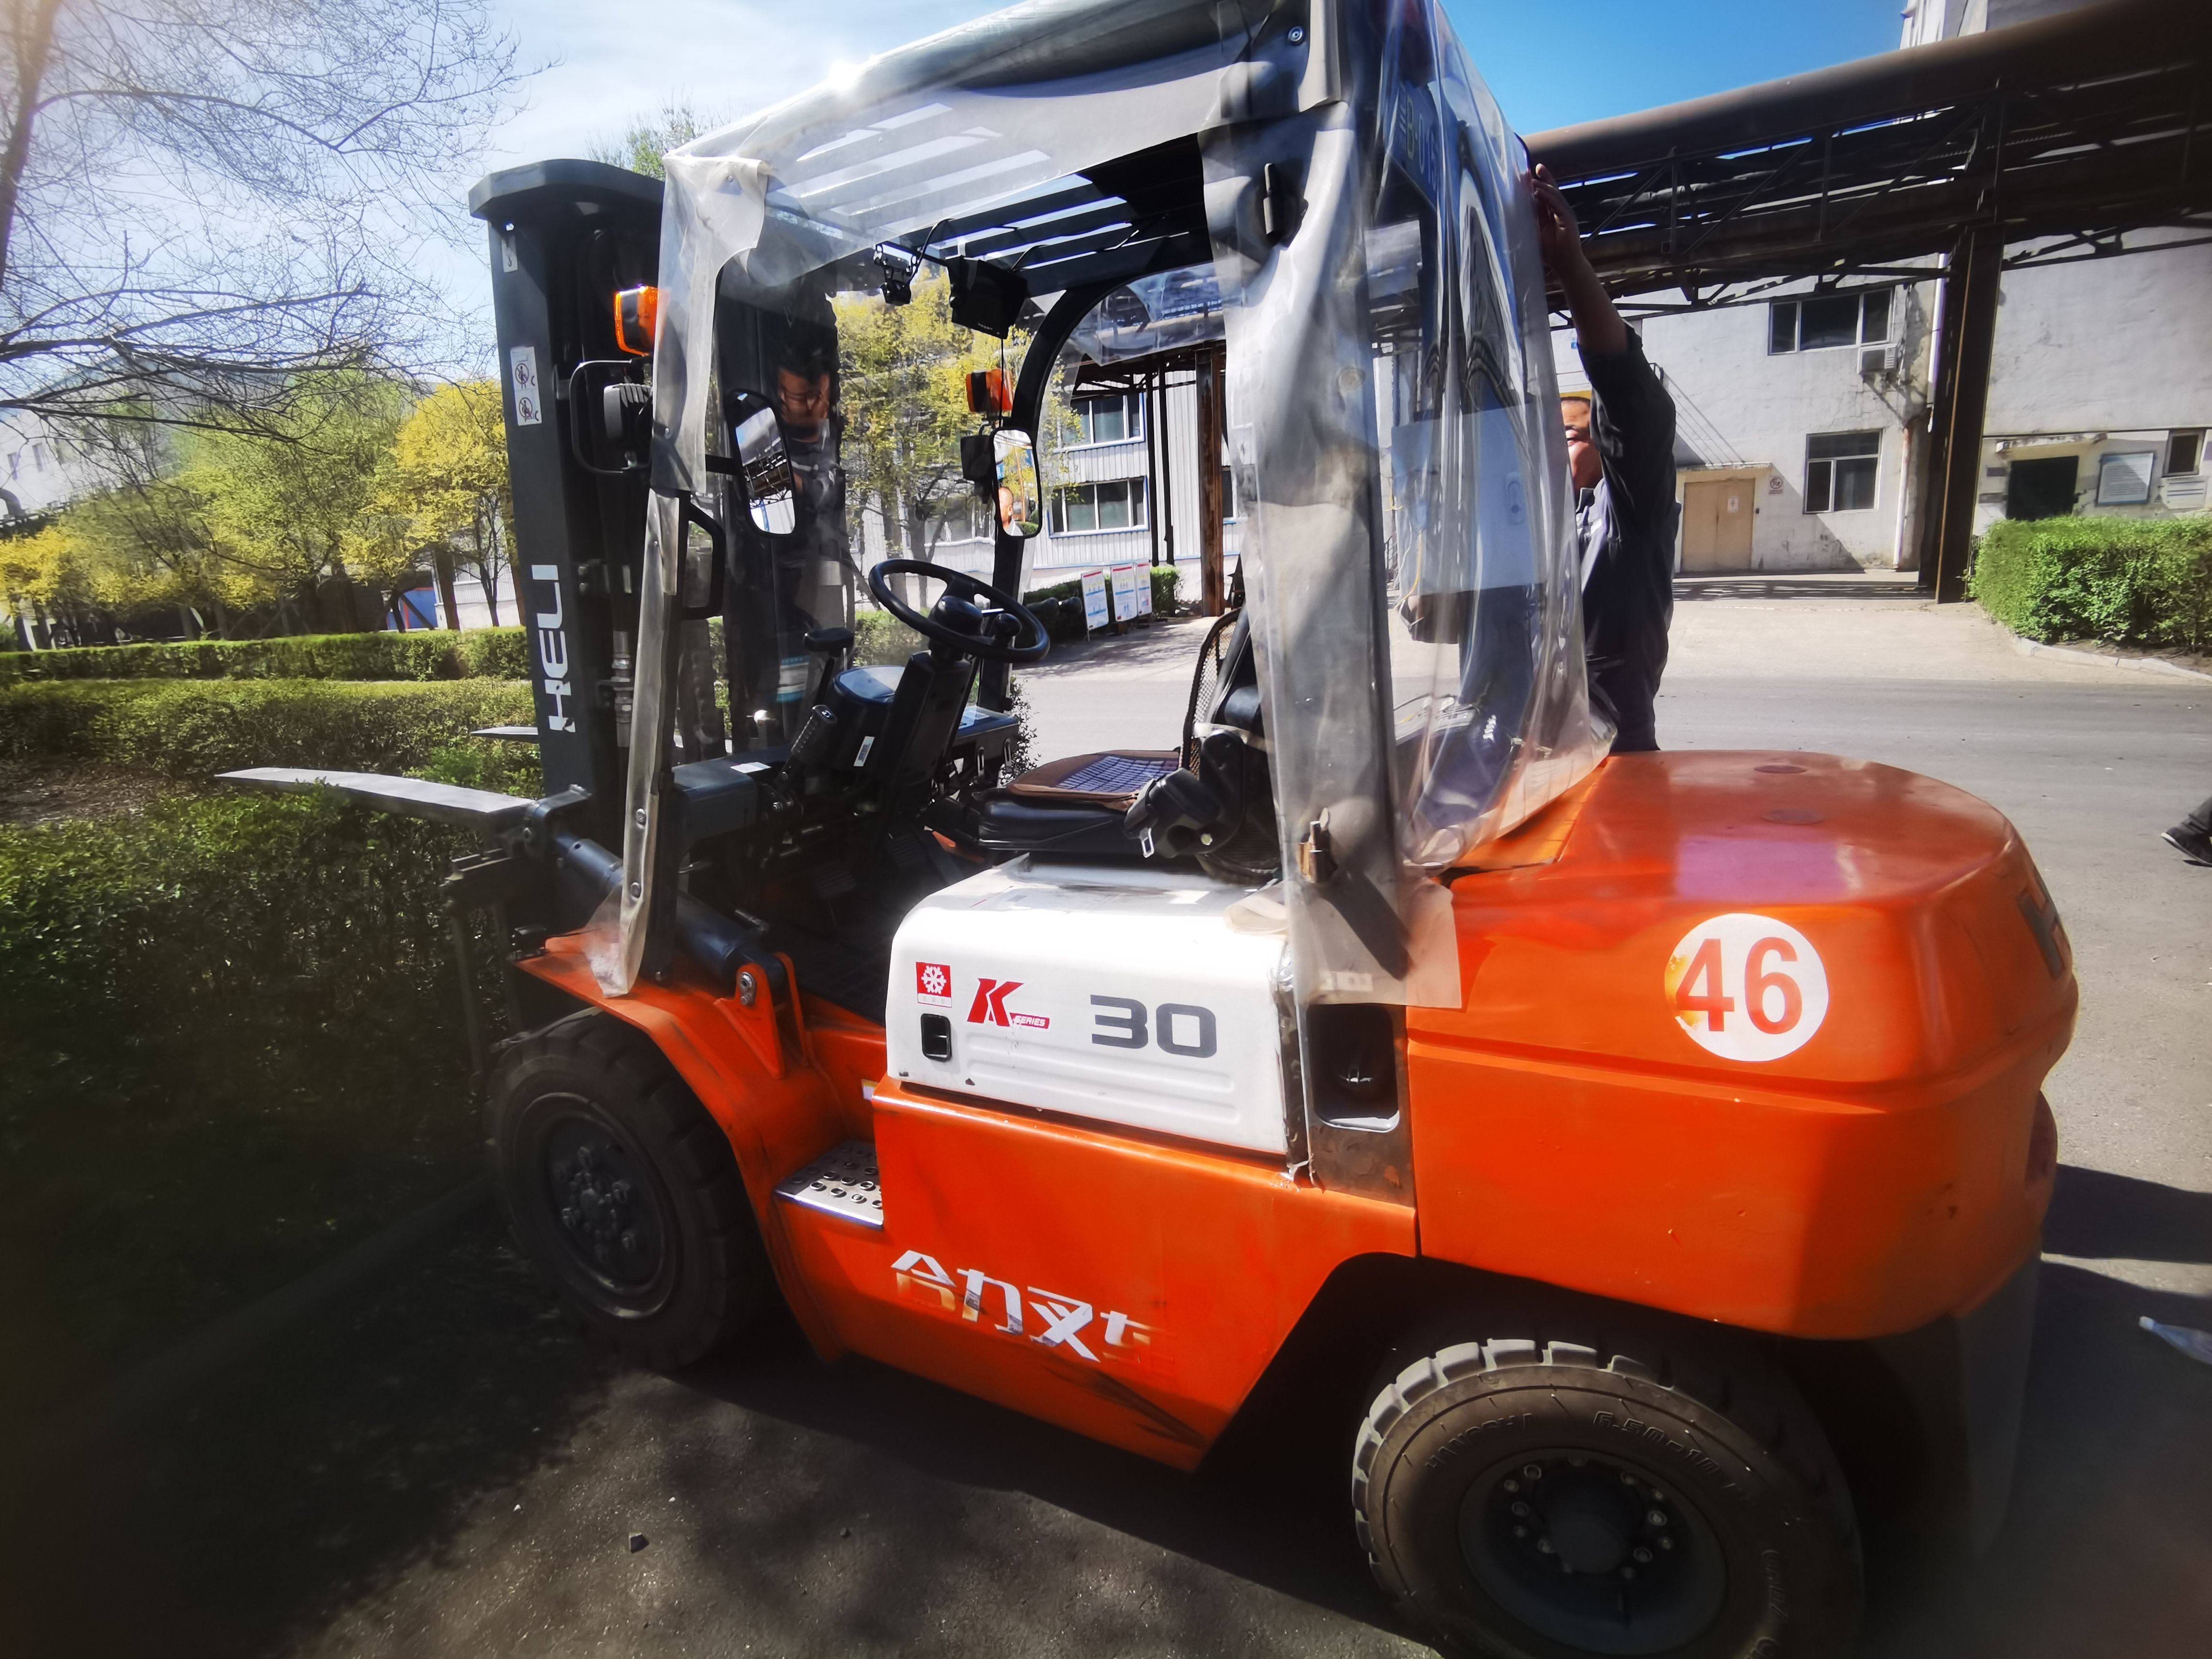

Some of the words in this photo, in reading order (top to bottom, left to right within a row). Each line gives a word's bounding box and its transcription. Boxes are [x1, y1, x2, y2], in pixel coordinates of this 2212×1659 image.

[531, 564, 576, 733] HELI
[967, 977, 1024, 1027] K
[1013, 1015, 1046, 1027] SERIES
[1675, 937, 1803, 1034] 46
[1090, 994, 1217, 1058] 30
